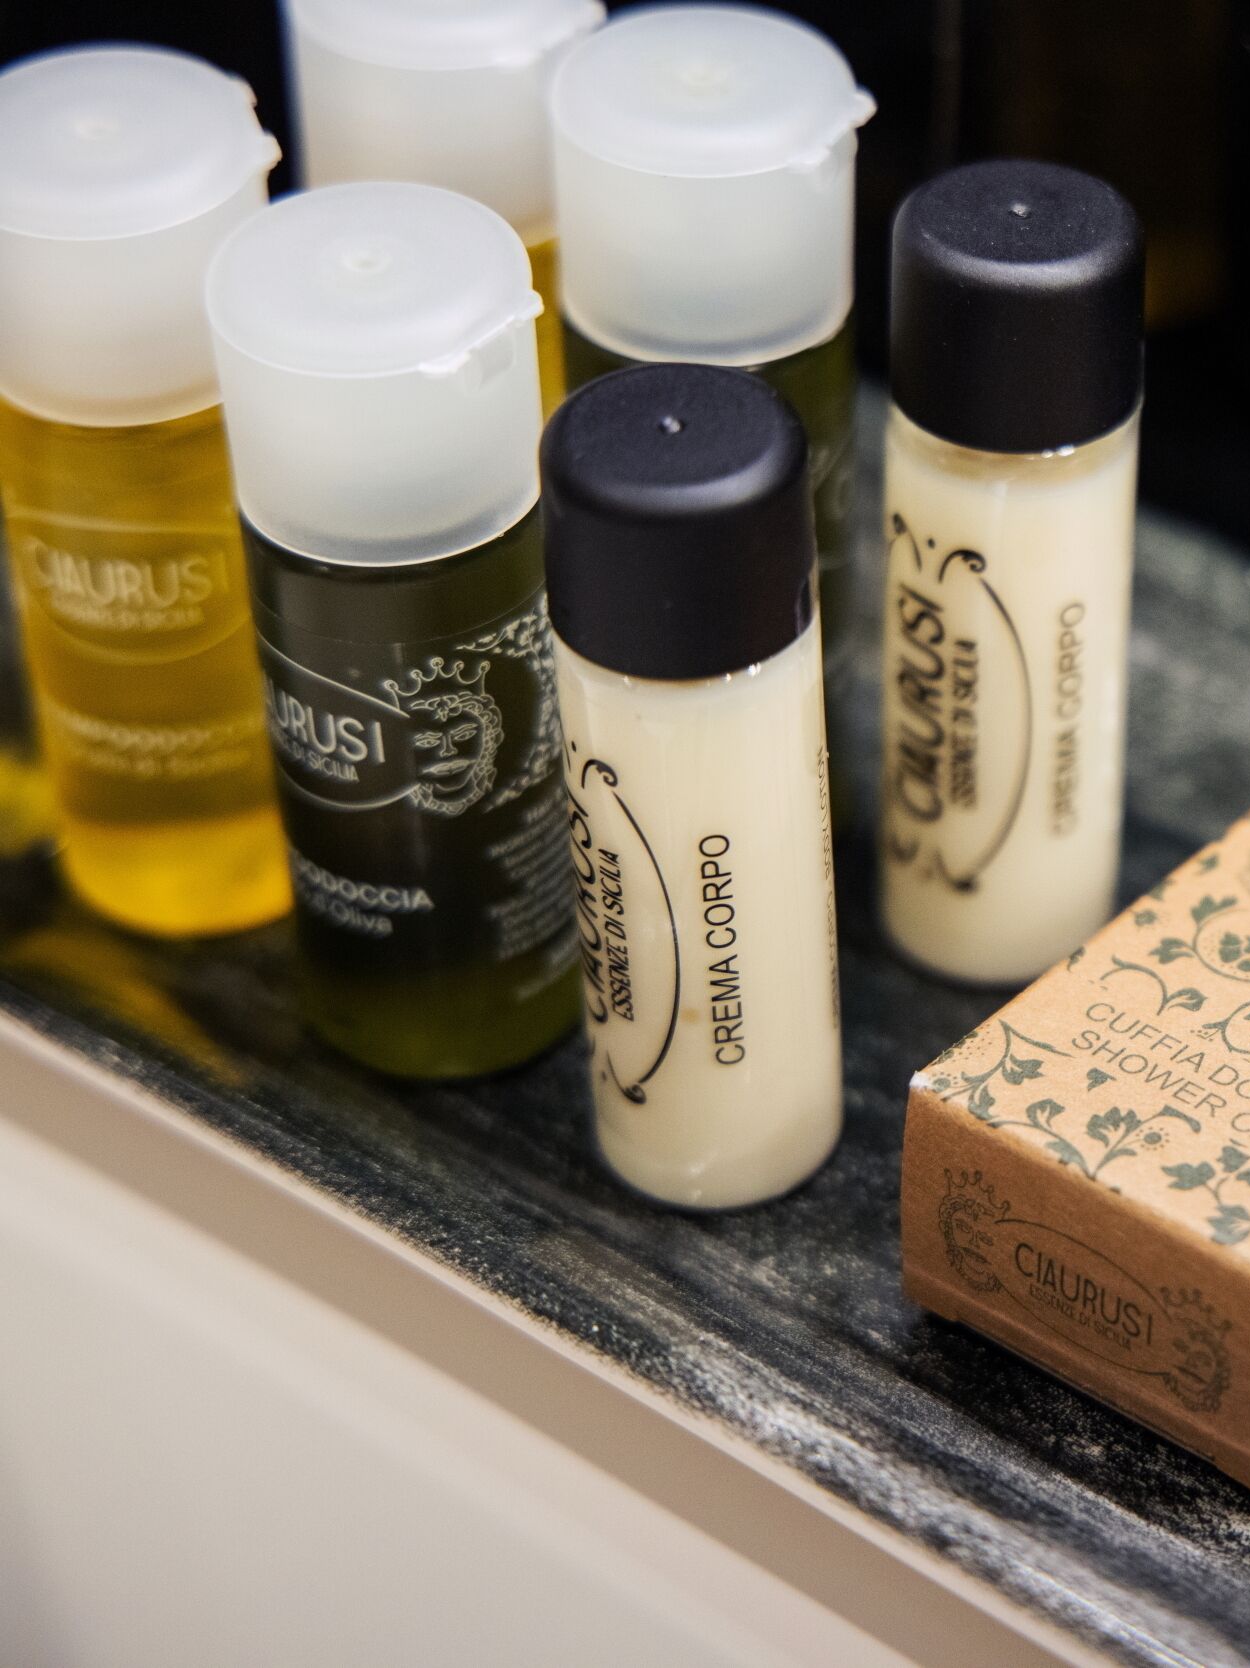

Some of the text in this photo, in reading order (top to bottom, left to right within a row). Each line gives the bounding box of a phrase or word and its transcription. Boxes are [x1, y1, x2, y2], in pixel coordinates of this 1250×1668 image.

[1055, 601, 1086, 721] CORPO
[598, 848, 635, 1022] ESSENZE DI SICILIA
[698, 834, 746, 1065] CREMA CORPO
[1070, 1029, 1228, 1119] SHOWER
[1084, 1001, 1207, 1074] CUFFIA
[1014, 1241, 1154, 1346] CIAURUSI
